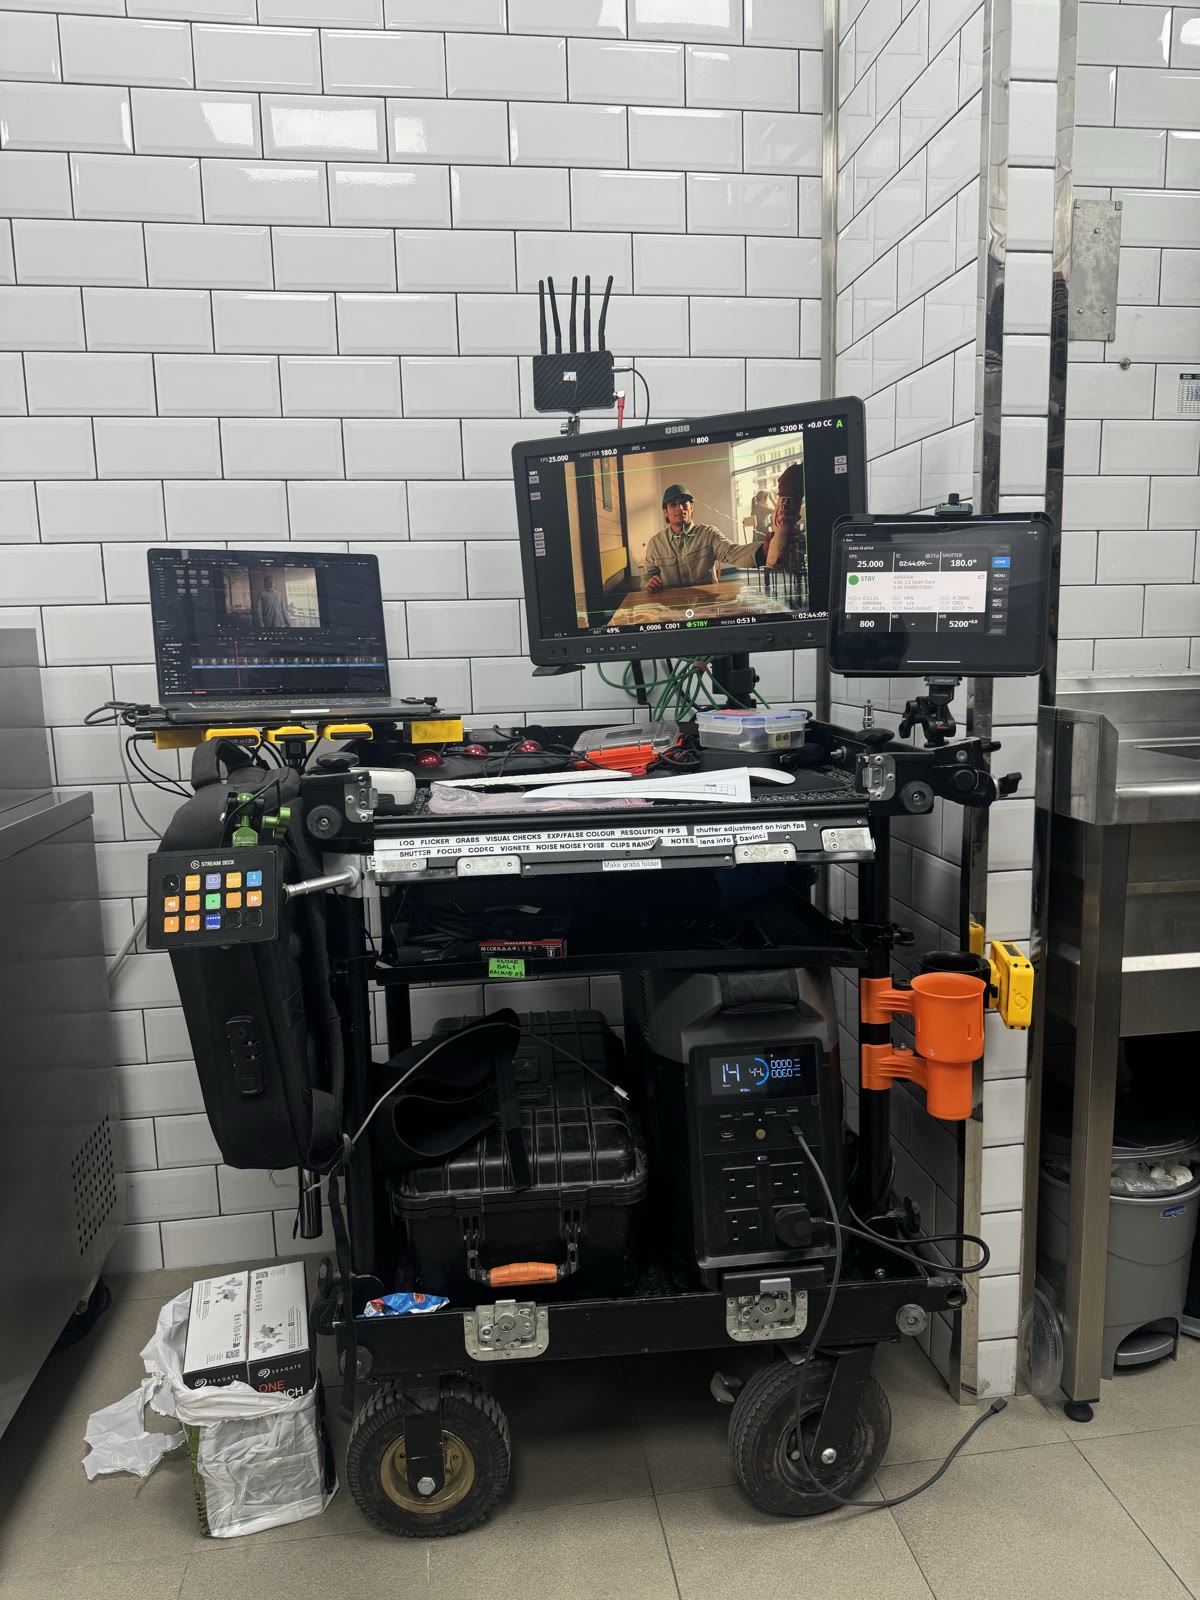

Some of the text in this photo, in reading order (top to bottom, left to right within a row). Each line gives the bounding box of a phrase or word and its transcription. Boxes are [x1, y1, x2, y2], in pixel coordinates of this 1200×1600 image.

[836, 419, 843, 428] A
[780, 424, 798, 433] 5200
[549, 455, 569, 463] 25.000
[776, 823, 791, 831] high
[740, 833, 766, 842] Davinci
[722, 1063, 739, 1083] 14
[772, 1069, 793, 1078] 0060
[272, 1364, 301, 1374] SEAGATE
[208, 1374, 239, 1384] SEAGATE
[259, 1380, 285, 1393] ONE
